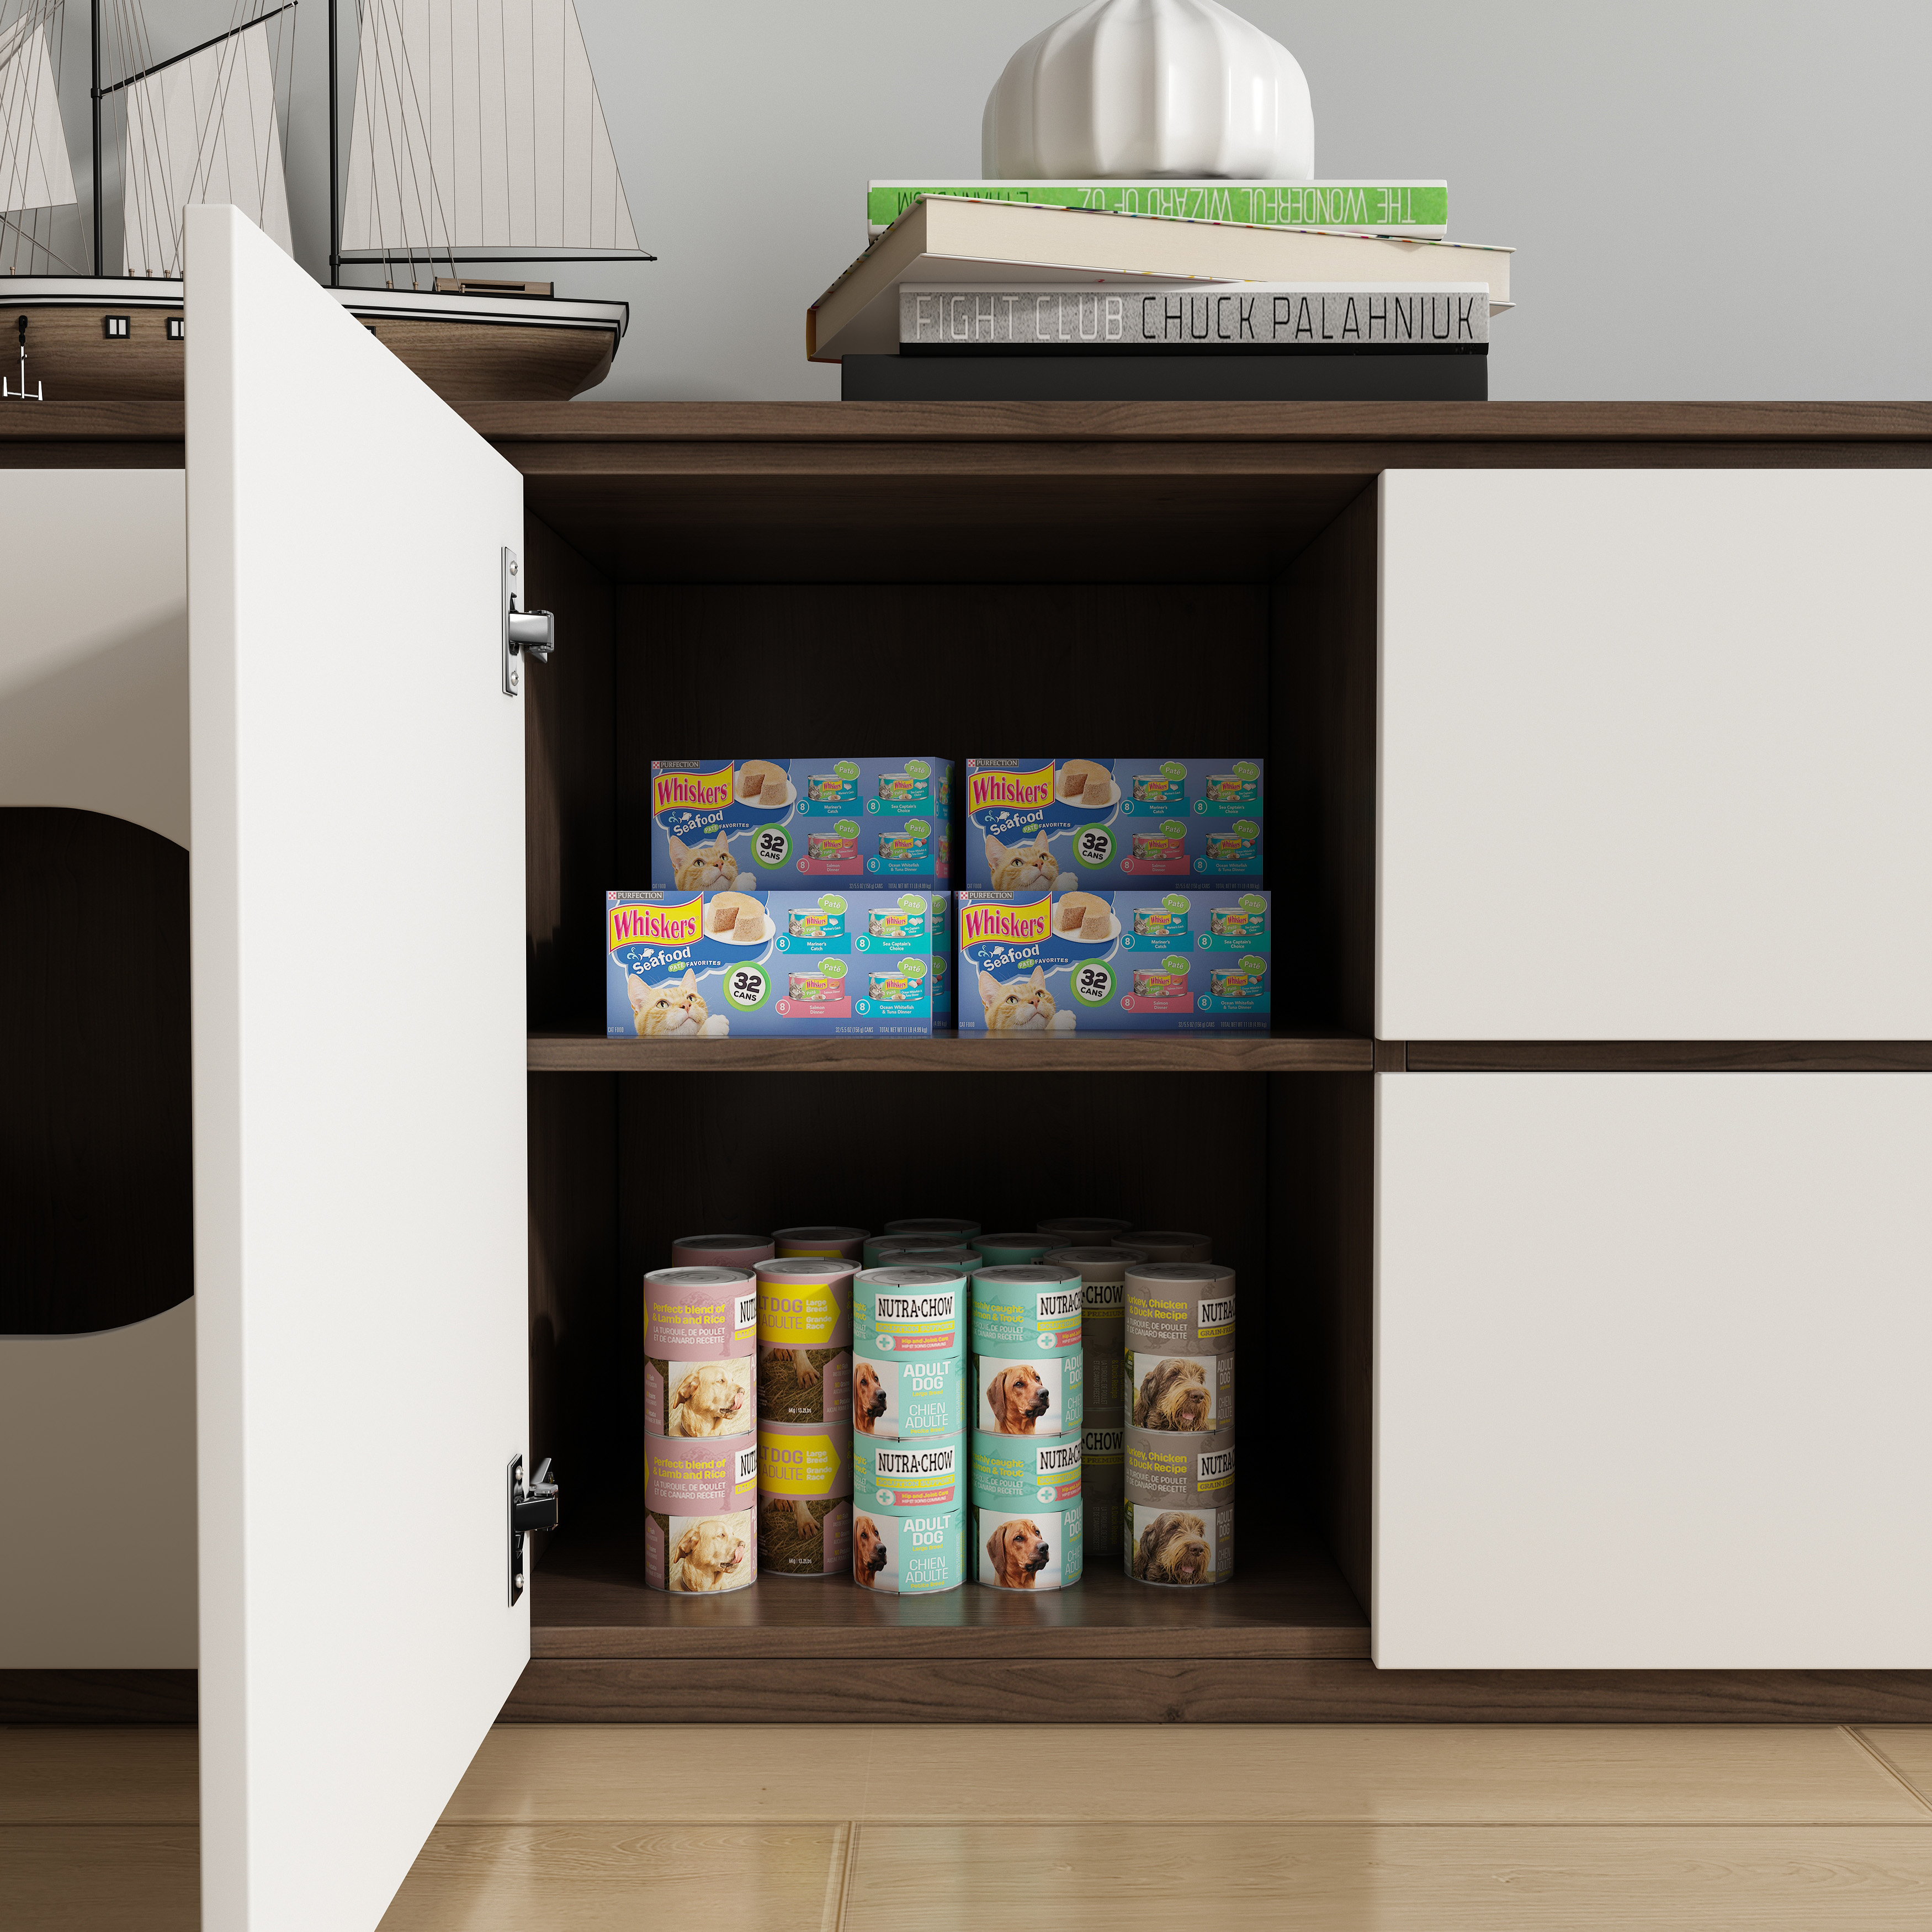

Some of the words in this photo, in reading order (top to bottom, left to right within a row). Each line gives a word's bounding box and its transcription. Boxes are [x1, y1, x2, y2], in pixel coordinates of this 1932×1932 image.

[1148, 188, 1232, 223] WIZARD
[1241, 188, 1367, 224] WONDERFUL
[1377, 188, 1416, 224] THE
[916, 295, 1019, 340] FIGHT
[1036, 296, 1123, 340] CLUB
[1142, 296, 1255, 339] CHUCK
[1272, 296, 1474, 339] PALAHNIUK
[657, 778, 728, 806] Whiskers
[973, 776, 1048, 805] Whiskers
[673, 810, 723, 836] Seafood
[990, 810, 1043, 835] Seafood
[760, 834, 784, 853] 32
[1082, 834, 1108, 852] 32
[760, 850, 780, 860] CANS
[1082, 850, 1103, 860] CANS
[825, 900, 841, 909] Paté
[904, 900, 920, 909] Paté
[1168, 899, 1184, 909] Paté
[1244, 900, 1260, 909] Paté
[613, 910, 696, 941] Whiskers
[806, 917, 826, 925] Whiskers
[887, 917, 906, 925] Whiskers
[965, 909, 1044, 940] Whiskers
[633, 946, 691, 974] Seafood
[983, 944, 1039, 971] Seafood
[825, 964, 841, 972] Paté
[904, 964, 920, 972] Paté
[1168, 961, 1184, 970] Paté
[1244, 961, 1260, 970] Paté
[734, 973, 762, 994] 32
[807, 980, 826, 989] Whiskers
[887, 980, 906, 989] Whiskers
[1081, 969, 1107, 990] 32
[734, 991, 757, 1001] CANS
[1080, 987, 1103, 997] CANS
[654, 1303, 683, 1314] Perfect
[685, 1305, 714, 1314] blend
[715, 1304, 726, 1313] of
[771, 1298, 803, 1313] DOG
[1127, 1294, 1147, 1308] Turkey,
[1149, 1299, 1187, 1309] Chicken
[991, 1305, 1024, 1314] caught
[1134, 1307, 1153, 1317] Duck
[1155, 1310, 1187, 1320] Recipe
[652, 1313, 657, 1321] &
[658, 1314, 681, 1324] Lamb
[682, 1316, 702, 1324] and
[762, 1314, 803, 1329] ADULTE
[999, 1314, 1024, 1323] Trout
[660, 1327, 687, 1336] TURQUIE,
[997, 1333, 1023, 1341] RECETTE
[1135, 1329, 1157, 1338] CANARD
[1158, 1331, 1187, 1340] RECETTE
[667, 1336, 694, 1344] CANARD
[903, 1361, 951, 1377] ADULT
[1217, 1357, 1233, 1373] ADULT
[912, 1376, 943, 1390] DOG
[1219, 1372, 1230, 1384] DOG
[910, 1402, 945, 1416] CHIEN
[1219, 1395, 1231, 1409] CHIEN
[1218, 1406, 1232, 1421] ADULTE
[905, 1414, 948, 1428] ADULTE
[903, 1515, 951, 1532] ADULT
[912, 1530, 943, 1546] DOG
[910, 1556, 946, 1570] CHIEN
[905, 1568, 948, 1584] ADULTE
